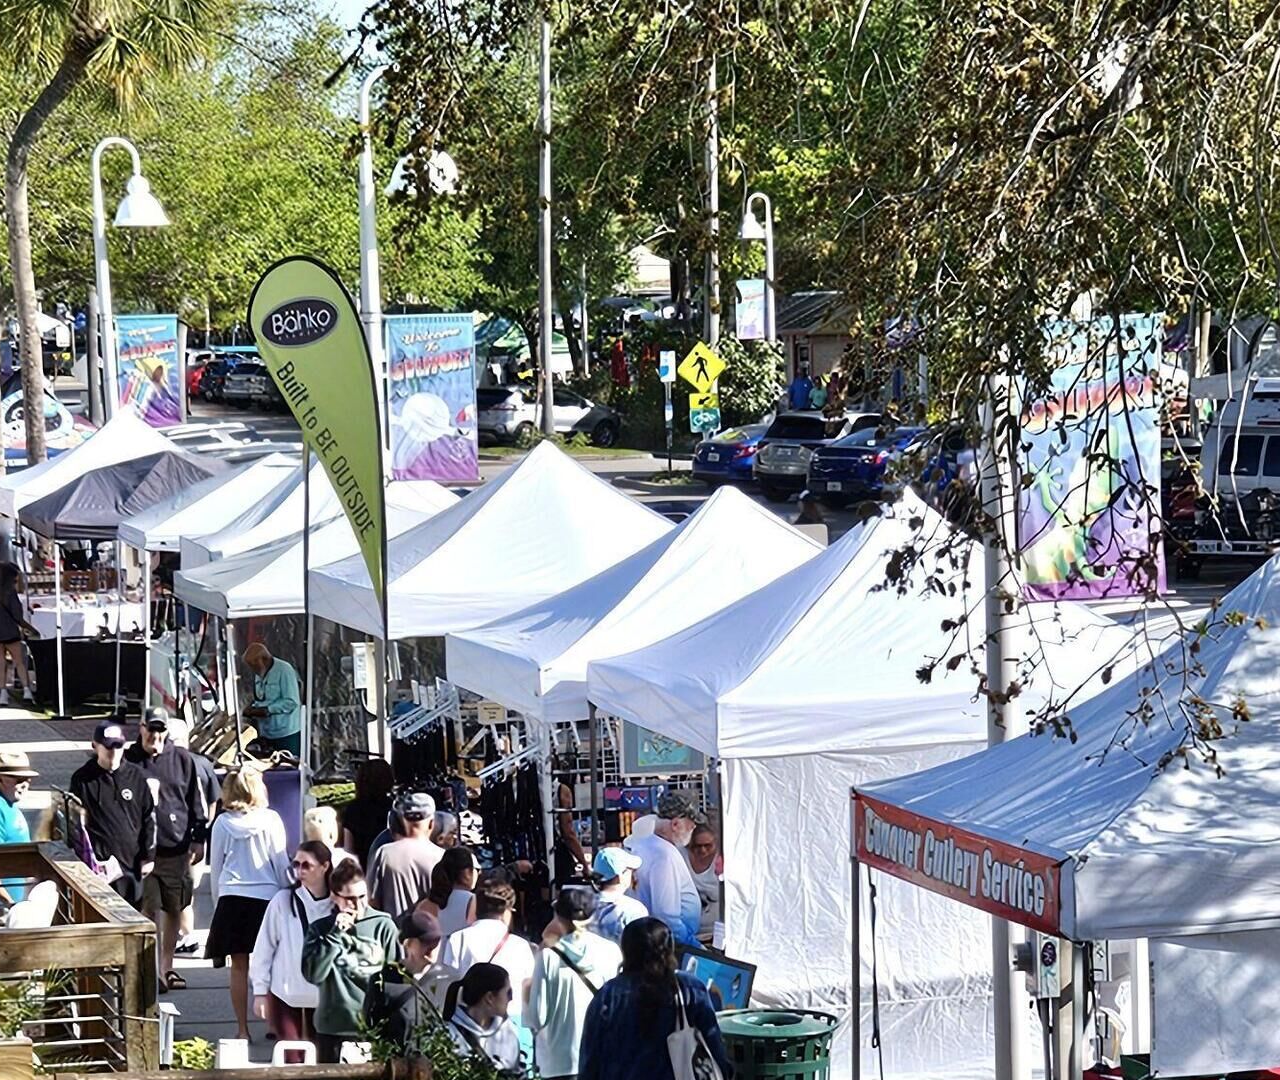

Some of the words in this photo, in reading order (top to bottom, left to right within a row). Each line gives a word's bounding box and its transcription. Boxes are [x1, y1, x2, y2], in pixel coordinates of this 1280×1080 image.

[276, 361, 309, 408] Built
[303, 406, 317, 430] to
[315, 428, 338, 457] BE
[864, 807, 921, 872] Conover
[923, 828, 980, 897] Cutlery
[981, 848, 1045, 917] Service
